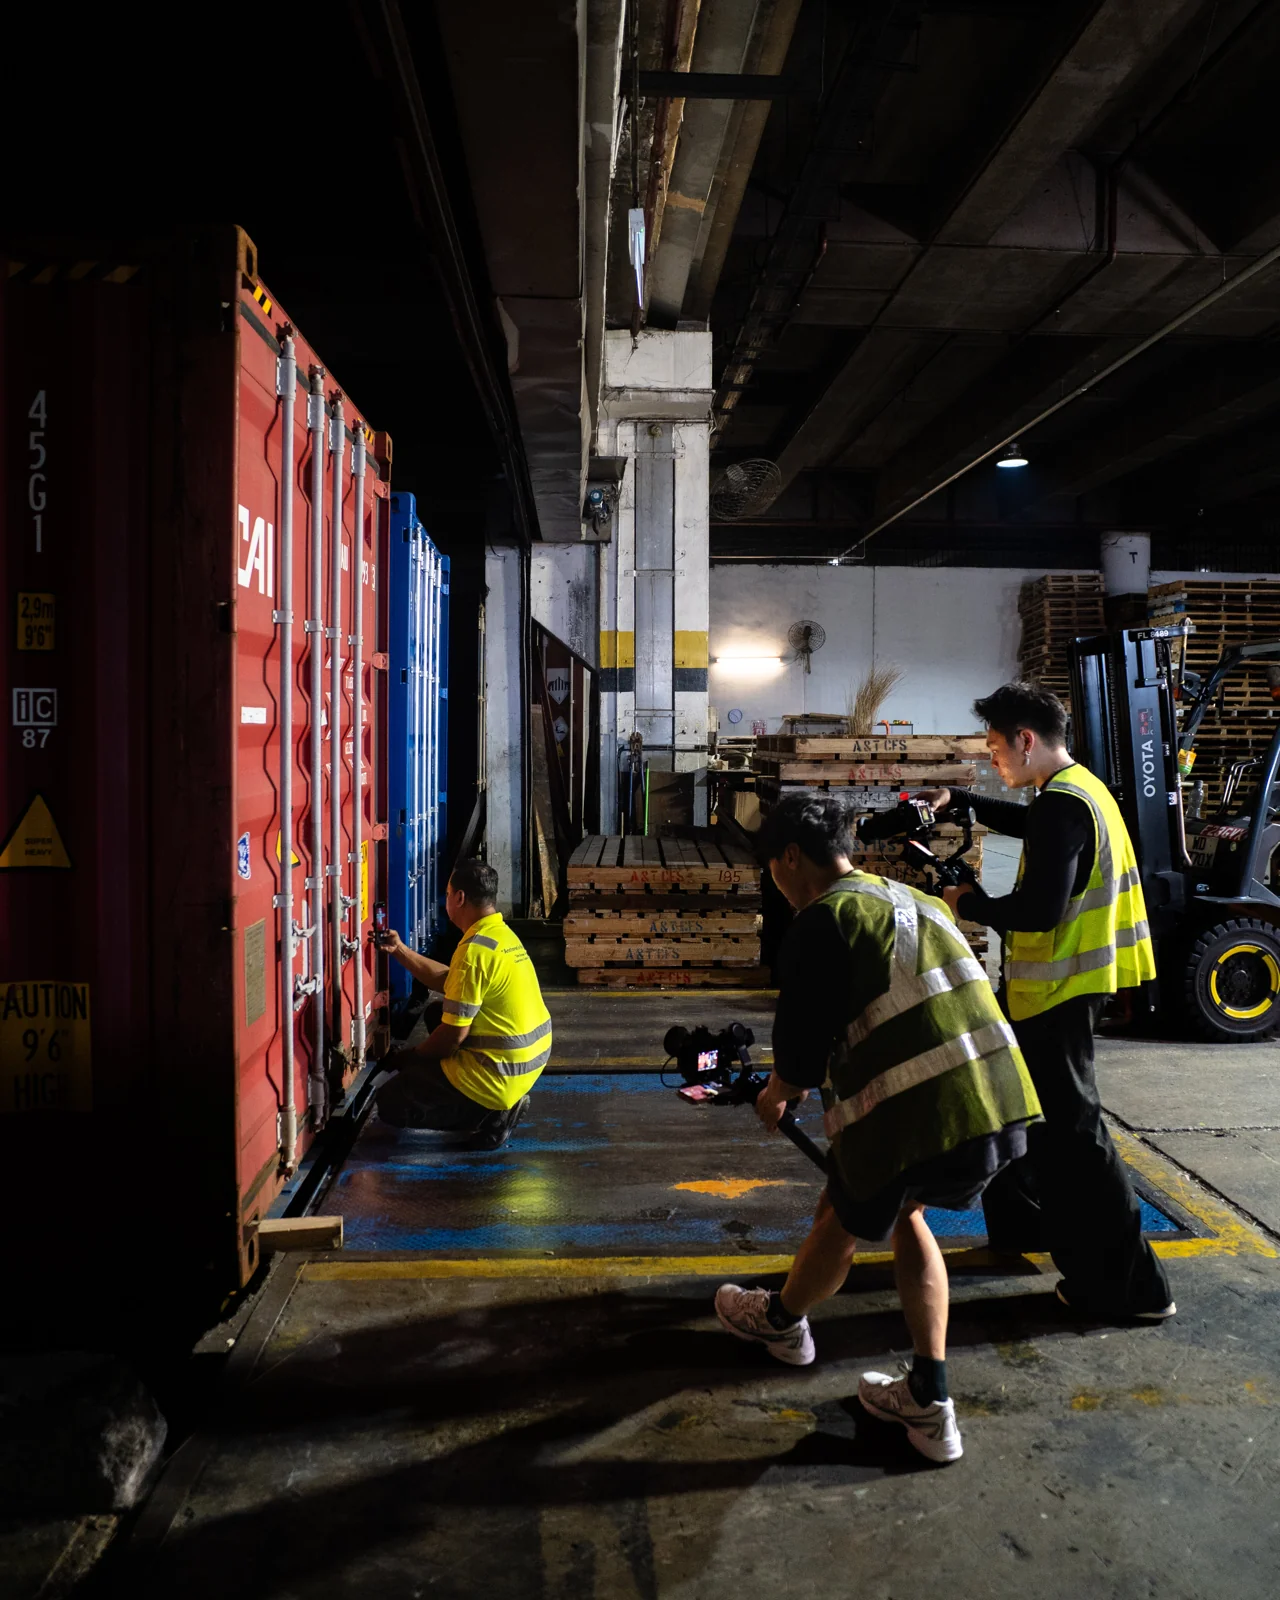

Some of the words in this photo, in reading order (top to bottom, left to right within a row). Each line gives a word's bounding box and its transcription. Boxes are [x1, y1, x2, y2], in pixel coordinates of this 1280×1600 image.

[1137, 631, 1148, 639] FL
[21, 728, 51, 749] 87
[1141, 739, 1157, 798] OYOTA
[718, 869, 743, 882] 185
[0, 983, 87, 1020] AUTION
